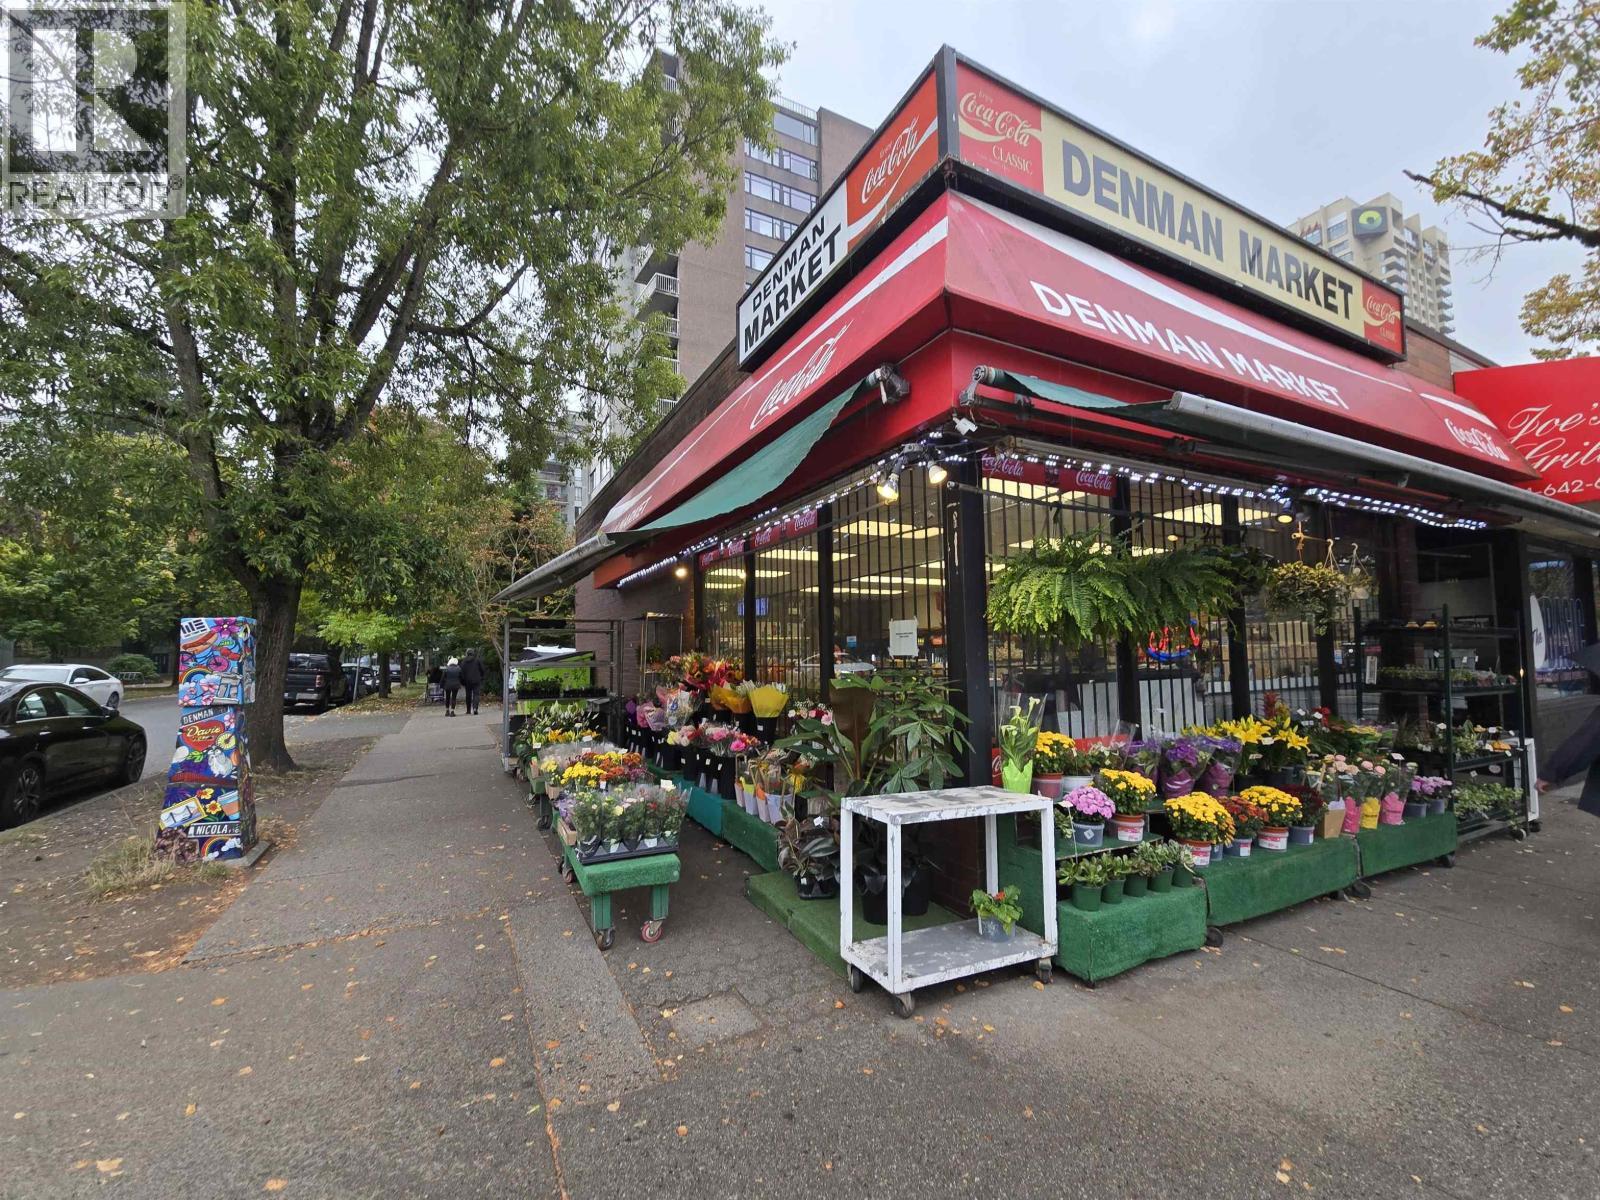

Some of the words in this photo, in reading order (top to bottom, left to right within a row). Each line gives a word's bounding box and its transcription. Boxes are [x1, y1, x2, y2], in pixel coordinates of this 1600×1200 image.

[959, 92, 1031, 147] Coca-Cola
[992, 144, 1033, 176] CLASSIC
[1061, 139, 1224, 263] DENMAN
[1238, 227, 1354, 320] MARKET
[743, 224, 842, 353] MARKET
[752, 215, 826, 313] DENMAN
[1029, 280, 1224, 369] DENMAN
[1220, 346, 1350, 410] MARKET
[1075, 470, 1113, 490] Coca-Cola
[183, 708, 214, 725] DENMAN
[196, 824, 228, 835] NICOLA
